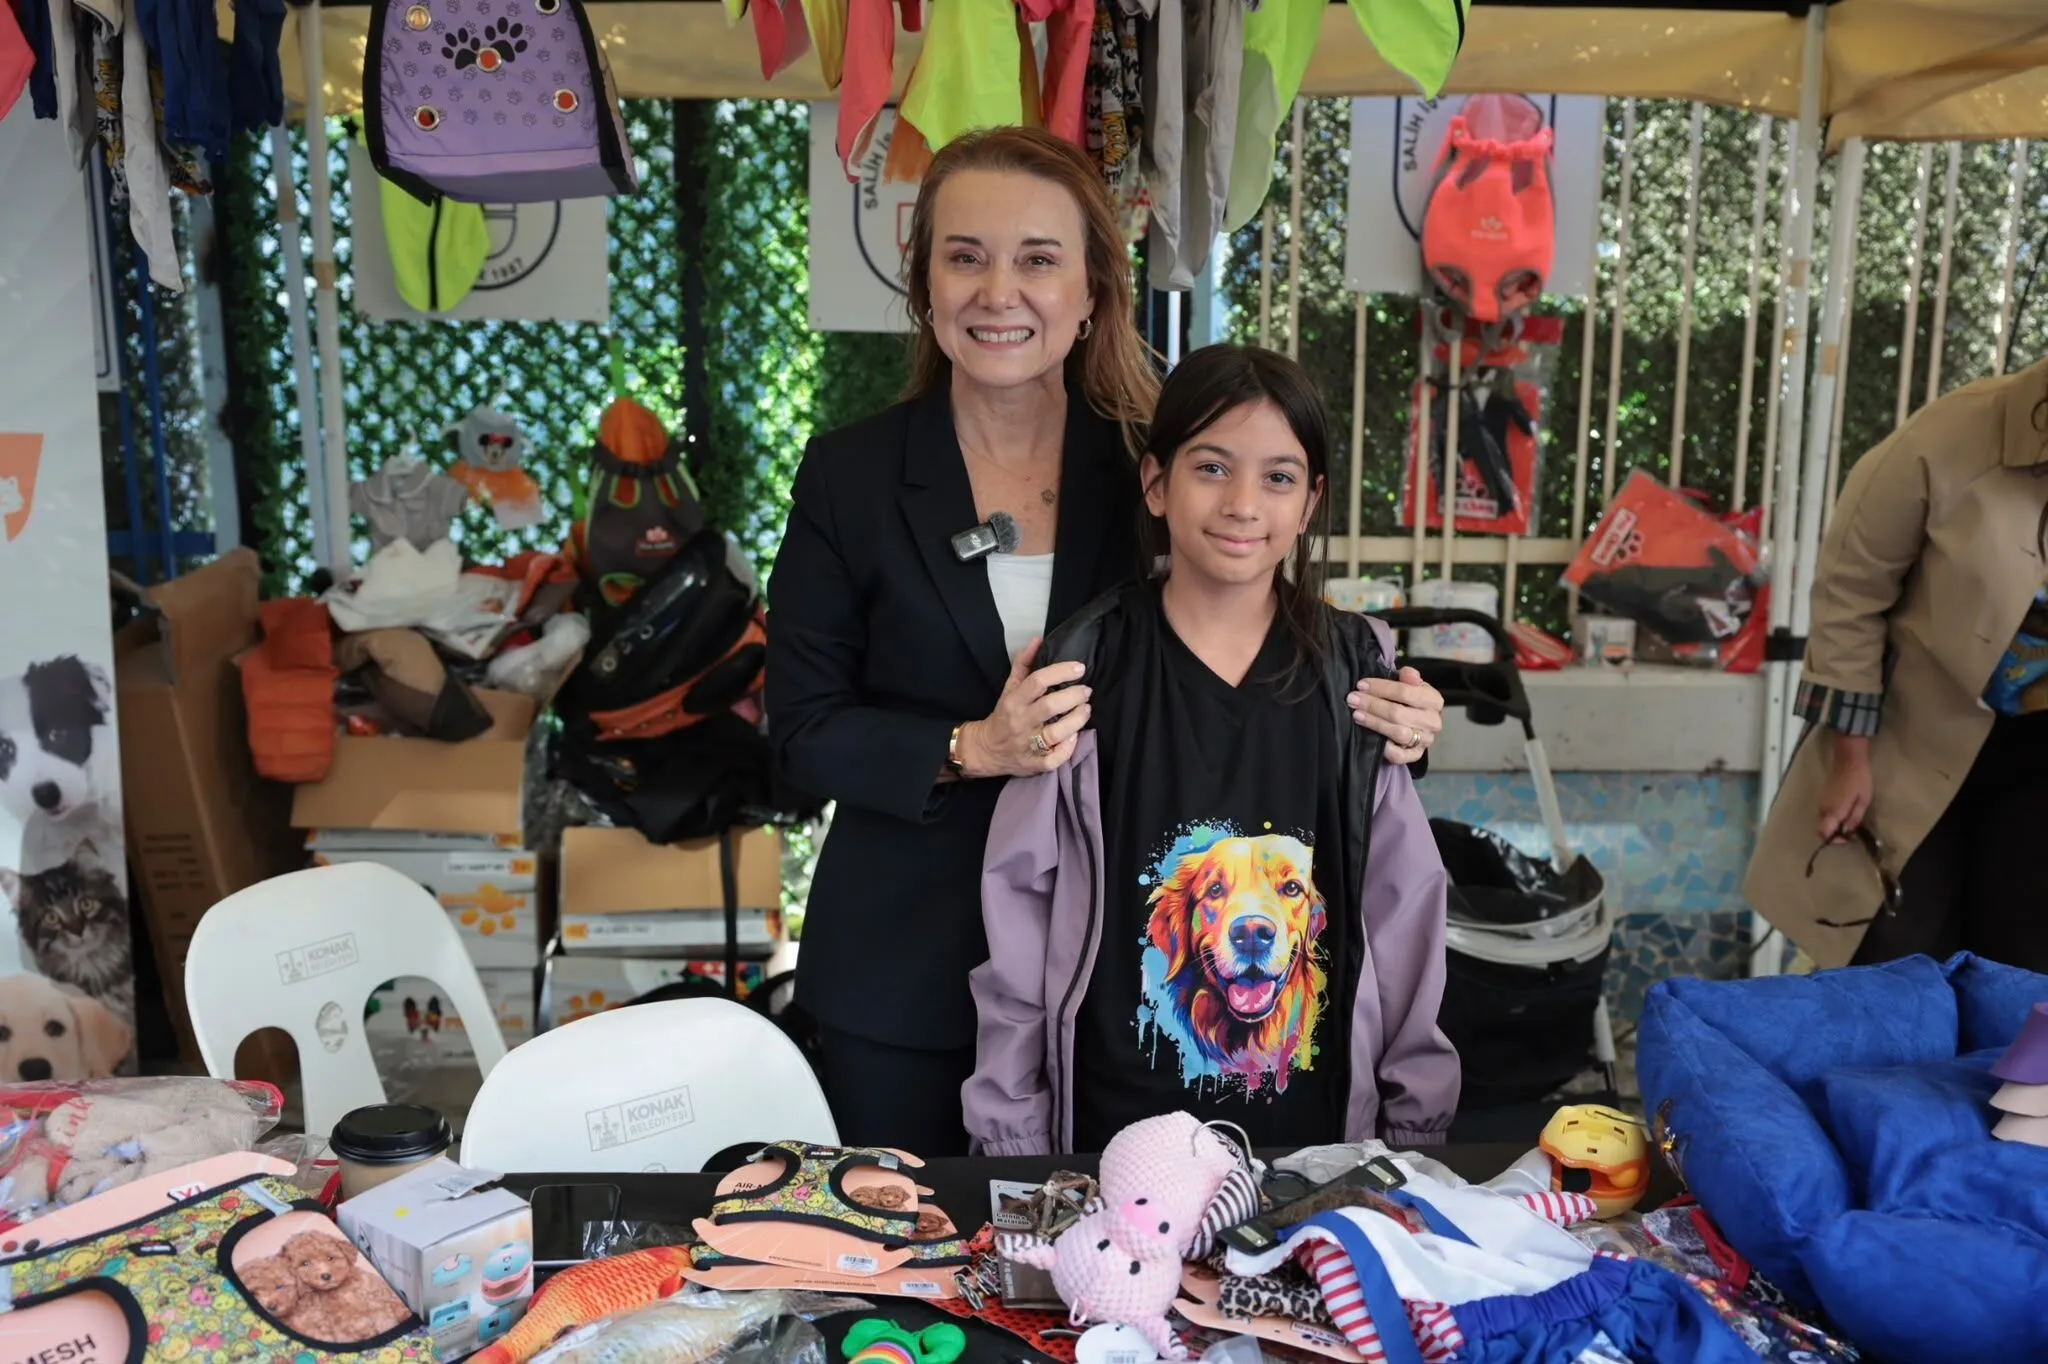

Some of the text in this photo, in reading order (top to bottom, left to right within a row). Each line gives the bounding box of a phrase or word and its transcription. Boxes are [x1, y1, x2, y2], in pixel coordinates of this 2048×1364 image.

[307, 938, 353, 961] KONAK
[627, 1093, 686, 1122] KONAK
[13, 1333, 96, 1364] ESH
